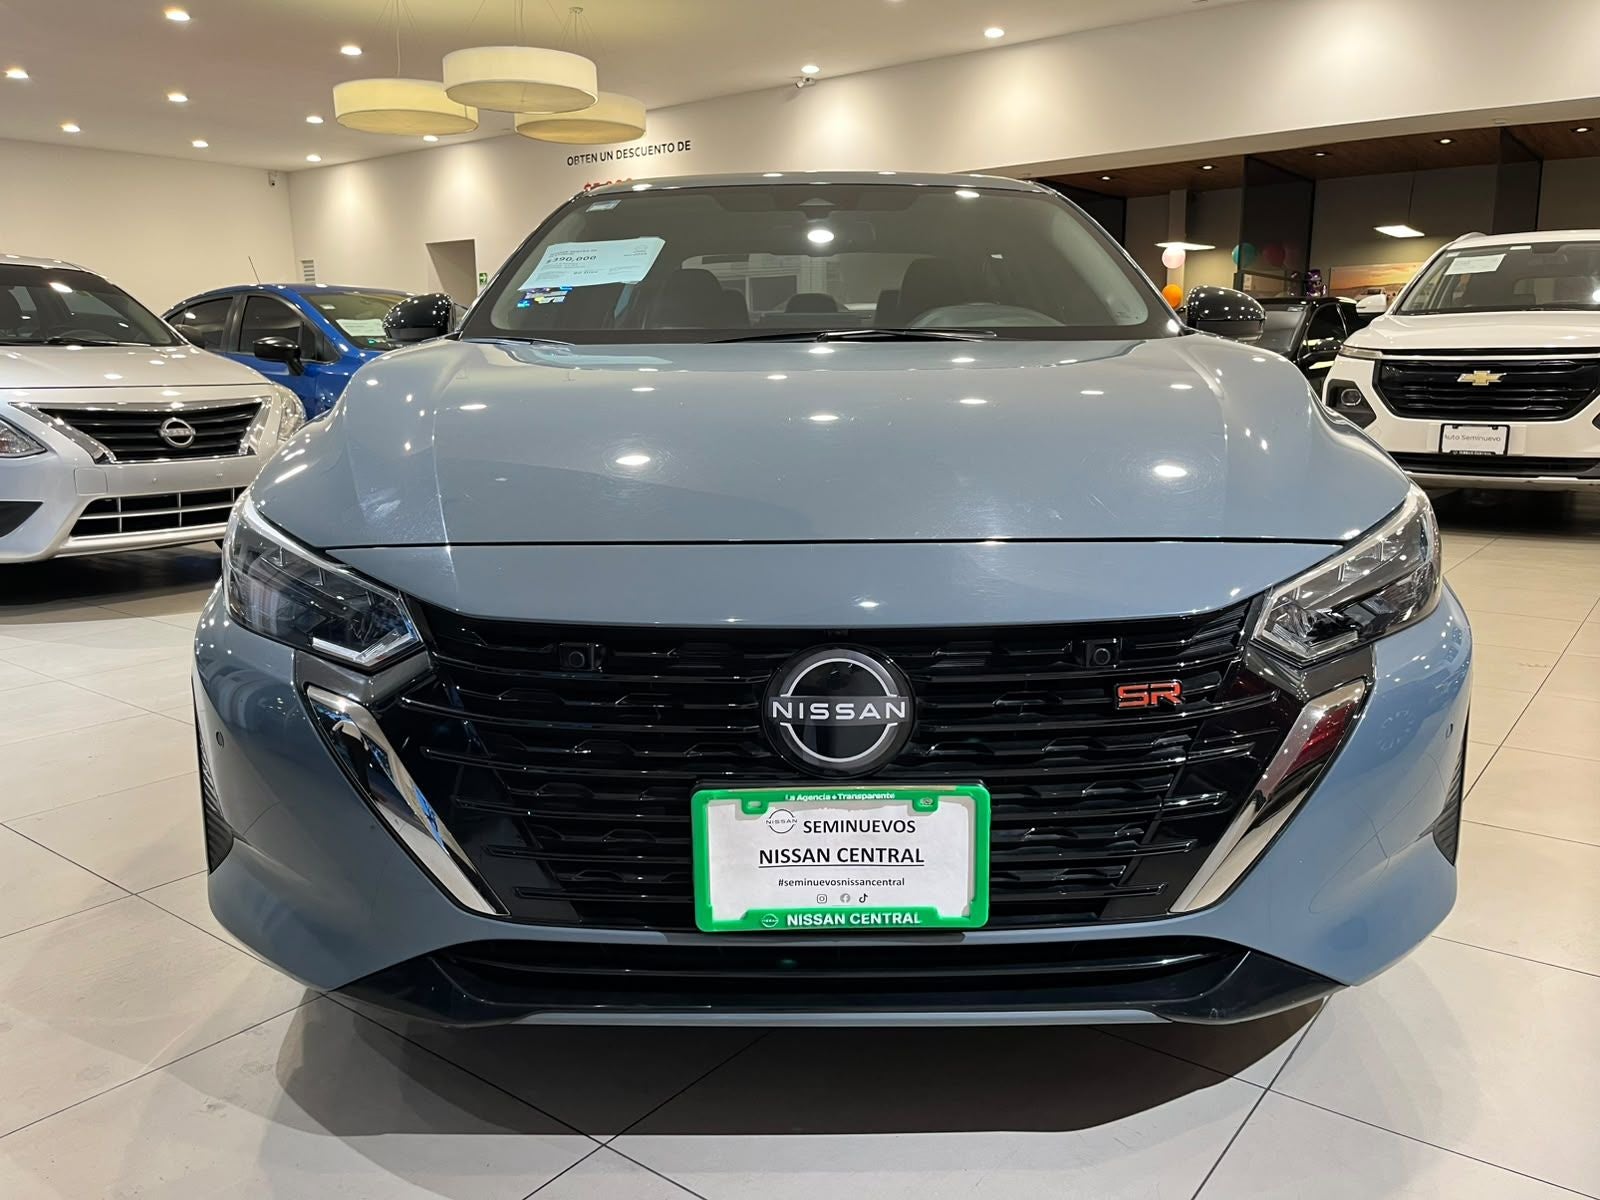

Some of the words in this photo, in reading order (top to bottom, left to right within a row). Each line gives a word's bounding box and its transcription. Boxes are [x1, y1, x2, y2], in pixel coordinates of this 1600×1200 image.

[567, 152, 598, 167] OBTEN
[600, 150, 614, 162] UN
[616, 142, 675, 160] DESCUENTO
[677, 140, 691, 152] DE
[1116, 680, 1184, 709] SR
[772, 701, 906, 721] NISSAN
[796, 793, 831, 802] Agencia
[803, 819, 916, 834] SEMINUEVOS
[759, 848, 831, 865] NISSAN
[836, 847, 925, 864] CENTRAL
[778, 876, 905, 887] #seminuevosnissancentral
[786, 913, 846, 926] NISSAN
[849, 911, 921, 925] CENTRAL
